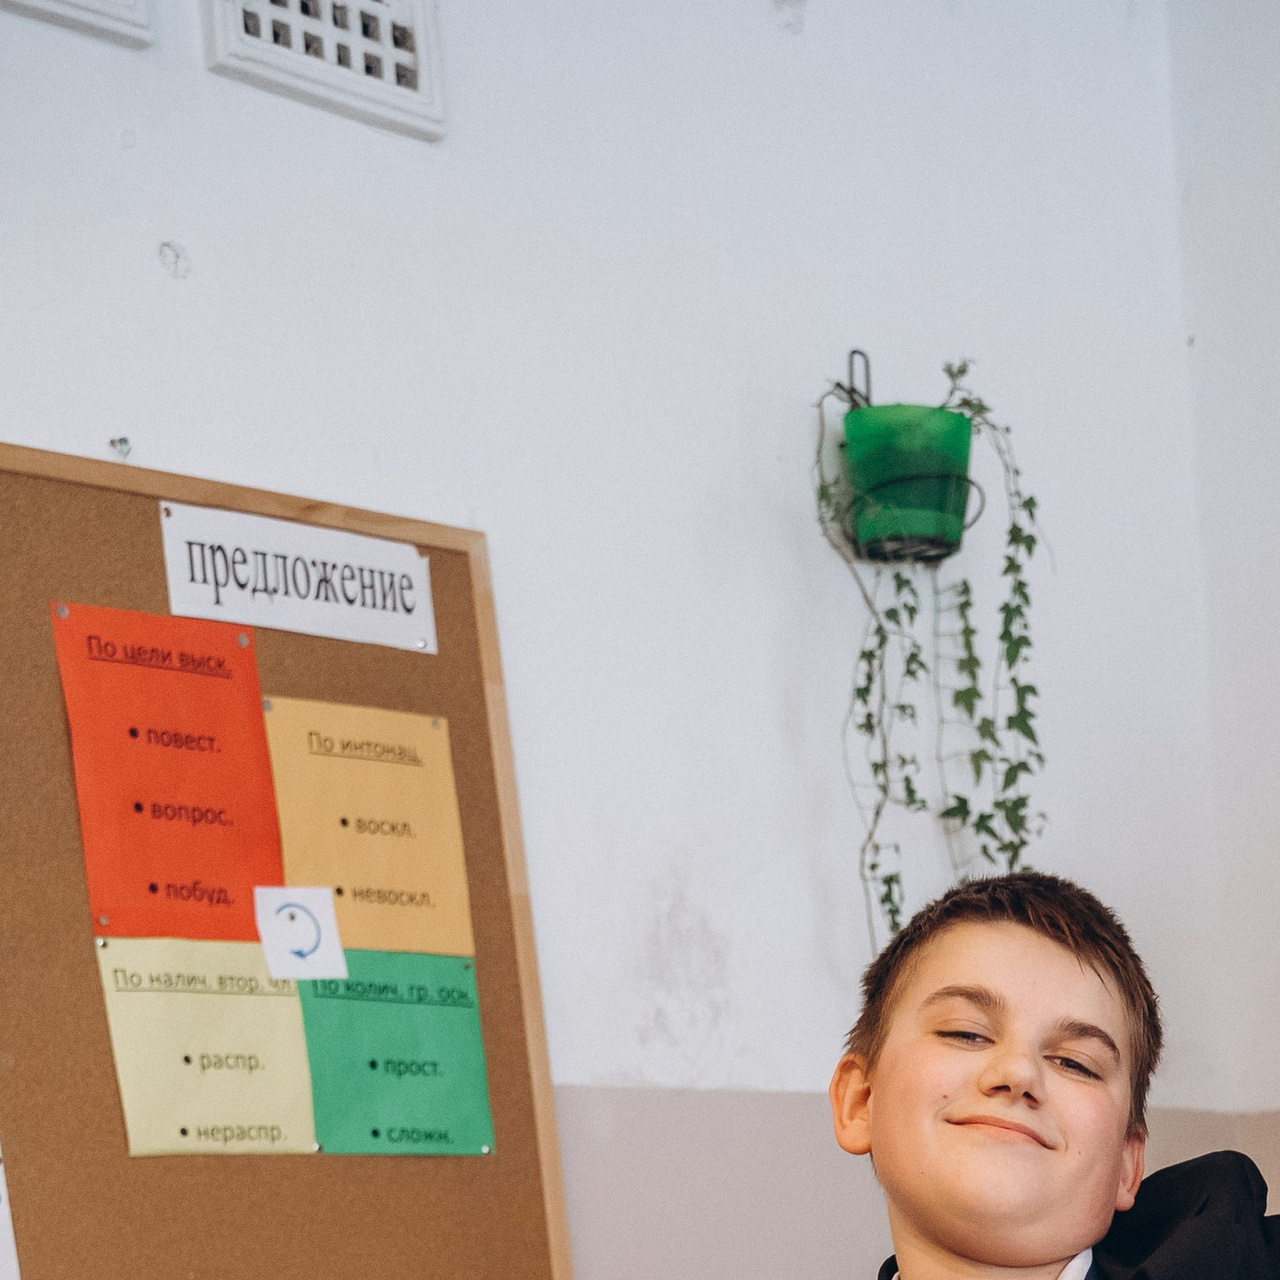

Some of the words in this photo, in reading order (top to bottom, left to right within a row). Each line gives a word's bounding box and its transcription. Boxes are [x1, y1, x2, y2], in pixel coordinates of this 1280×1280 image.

[186, 540, 417, 615] предложение
[87, 635, 117, 659] По
[123, 644, 173, 669] цели
[179, 650, 232, 678] выск.
[146, 729, 222, 754] повест.
[308, 731, 335, 753] По
[150, 802, 234, 828] вопрос.
[355, 817, 416, 837] воскл.
[166, 881, 235, 908] побуд.
[351, 888, 437, 908] невоскл.
[114, 968, 142, 988] По
[199, 1052, 265, 1072] распр.
[384, 1057, 443, 1078] прост.
[196, 1124, 287, 1145] нераспр.
